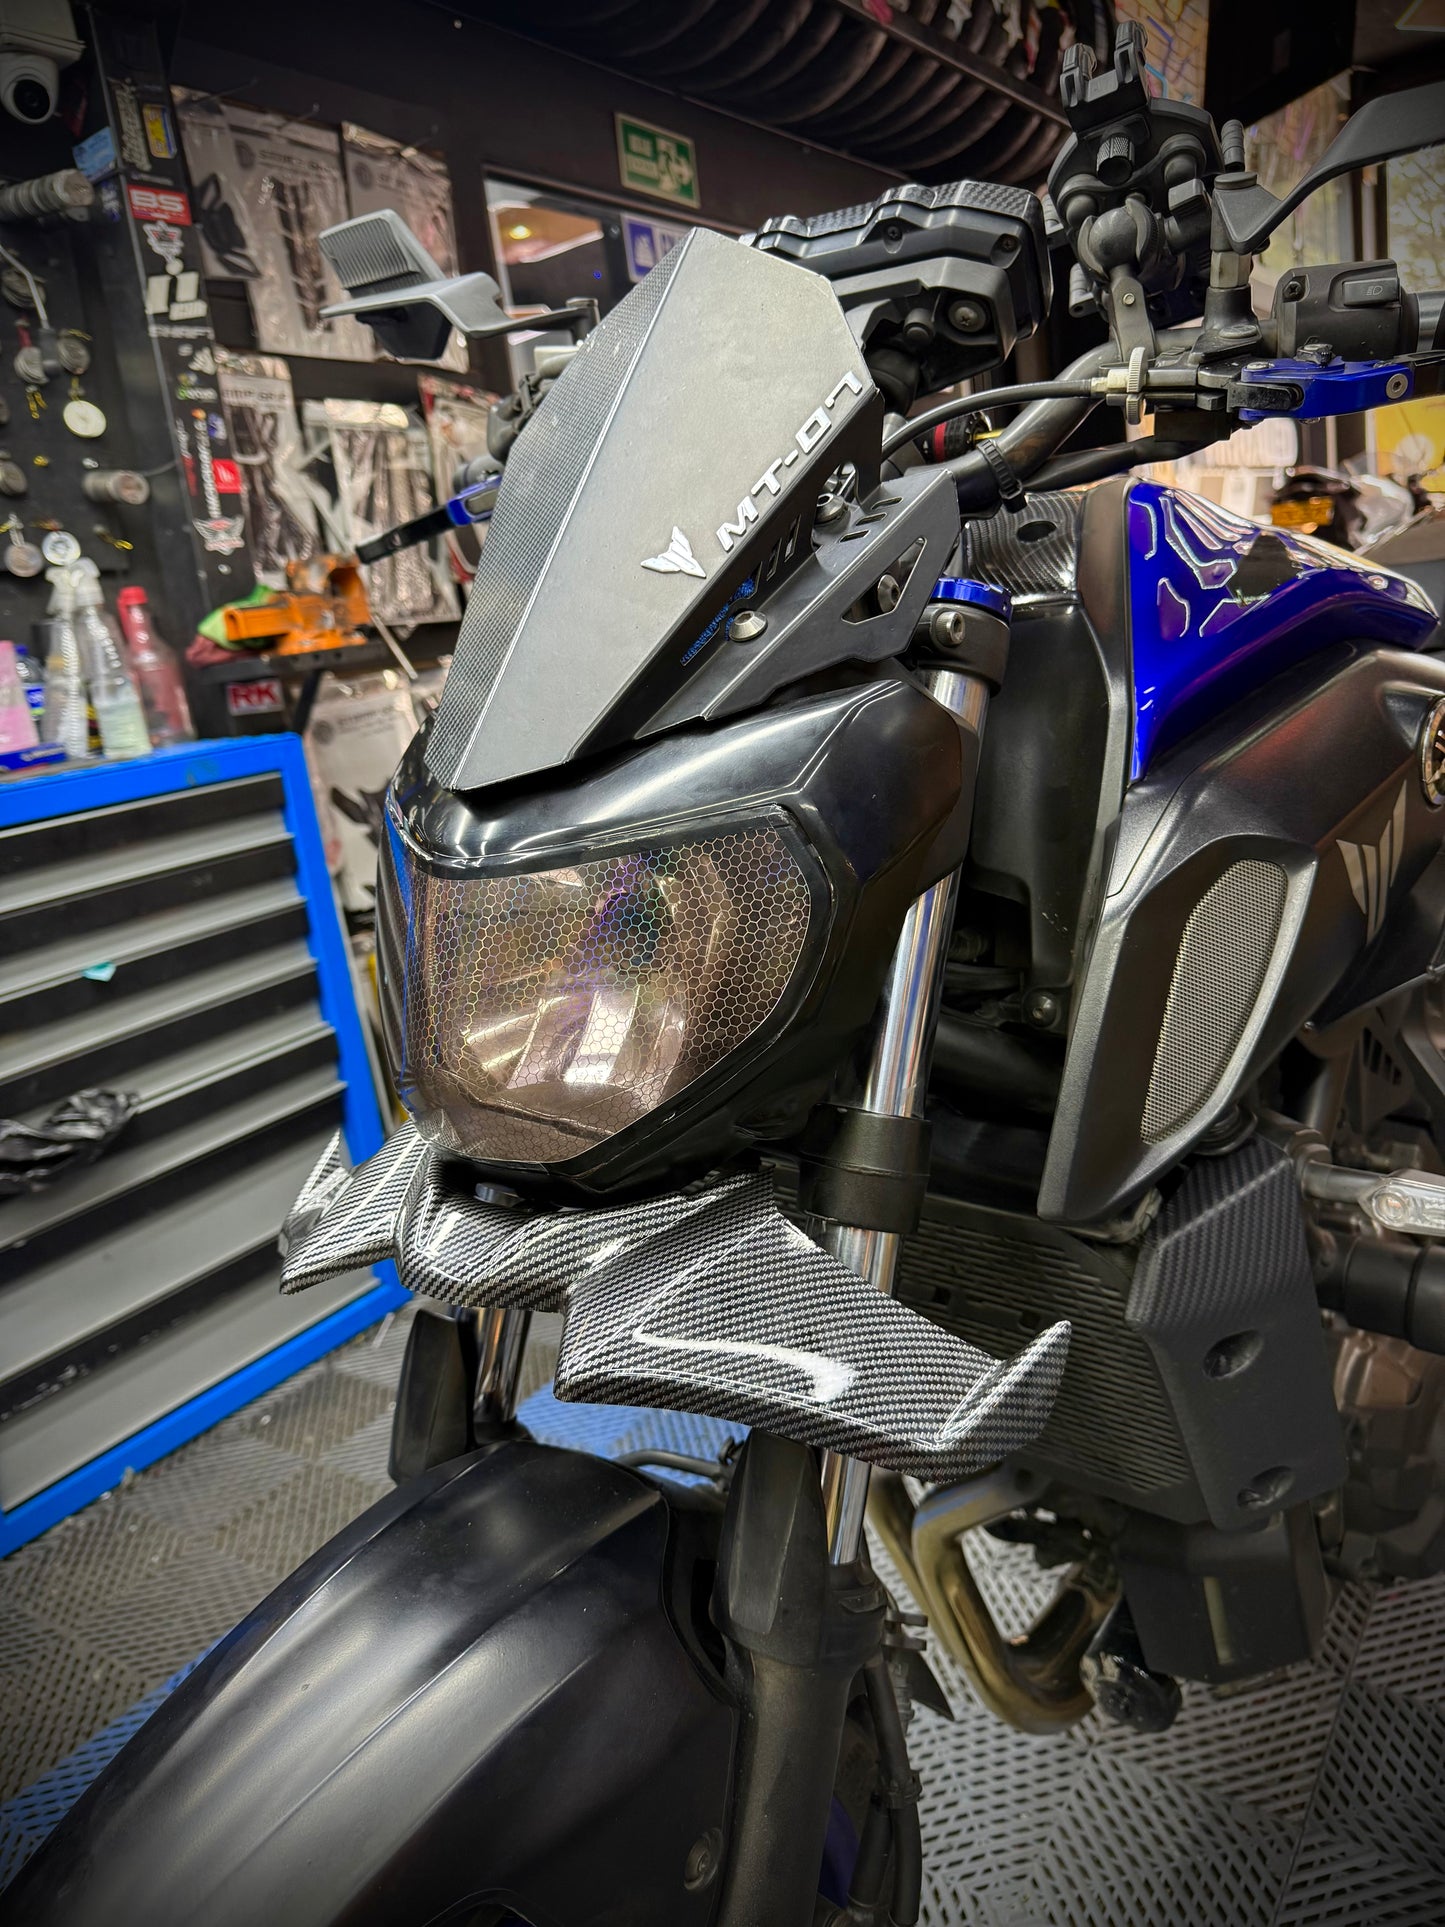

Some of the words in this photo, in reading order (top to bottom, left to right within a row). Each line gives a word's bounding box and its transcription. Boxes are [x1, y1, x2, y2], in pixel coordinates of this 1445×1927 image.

[129, 189, 185, 212] BS
[717, 371, 862, 551] MT-07
[230, 682, 276, 708] RK
